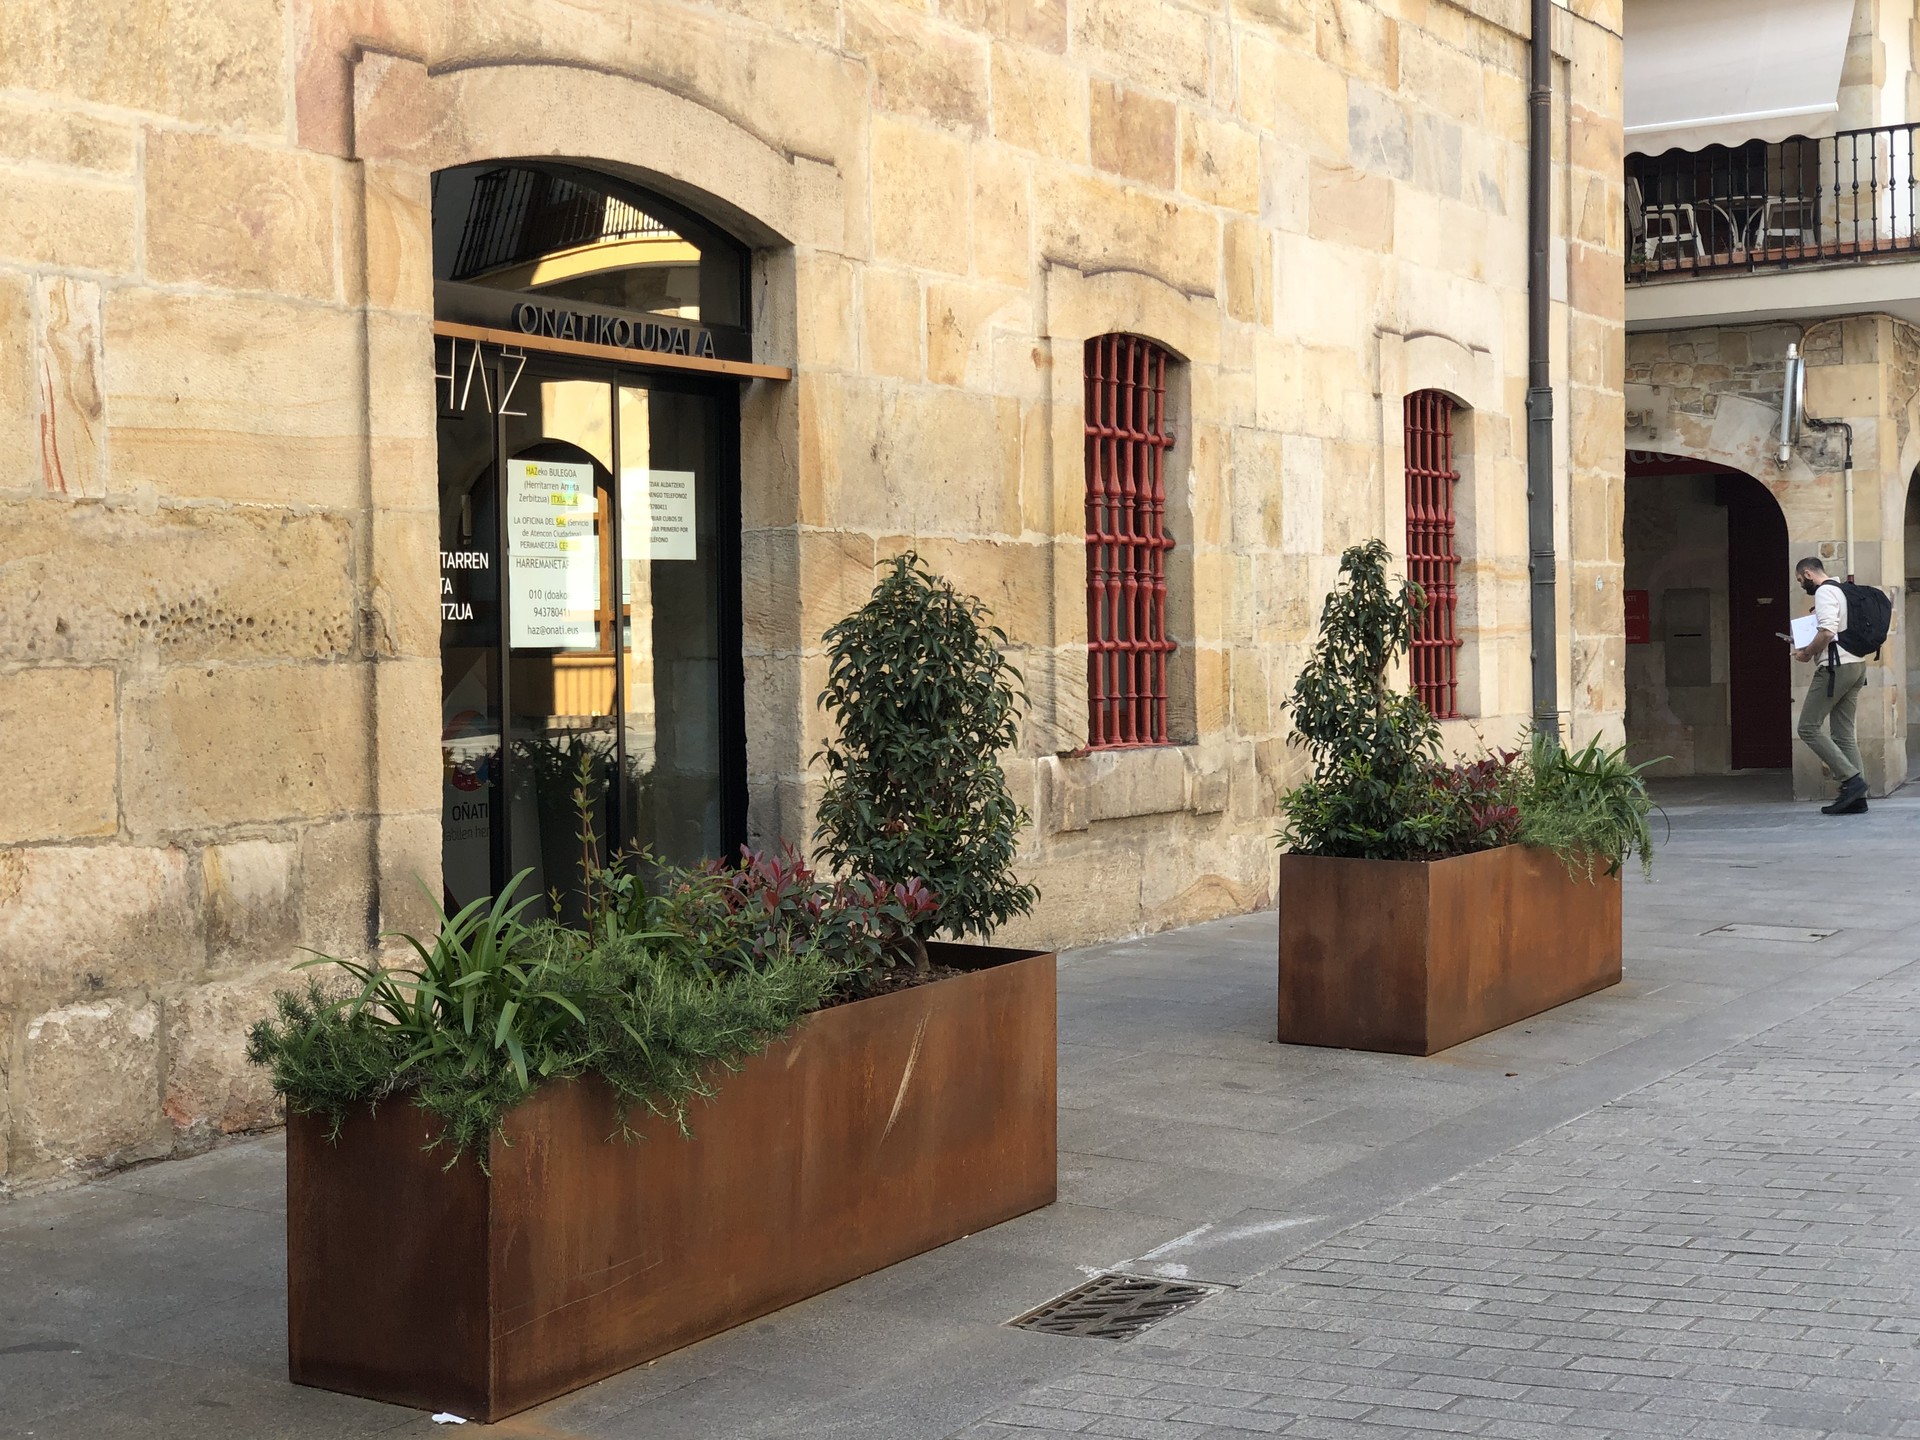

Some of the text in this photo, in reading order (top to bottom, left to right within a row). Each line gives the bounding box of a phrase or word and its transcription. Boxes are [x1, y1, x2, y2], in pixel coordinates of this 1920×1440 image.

[634, 322, 716, 359] UDALA
[526, 466, 577, 478] HAZeko BULEGOA
[519, 494, 549, 504] Zerbitzua)
[514, 517, 520, 525] LA
[522, 517, 544, 525] OFICINA
[545, 518, 555, 526] DEL
[529, 589, 542, 600] 010
[527, 625, 579, 635] haz@onati.eus
[452, 802, 488, 821] OÑATI
